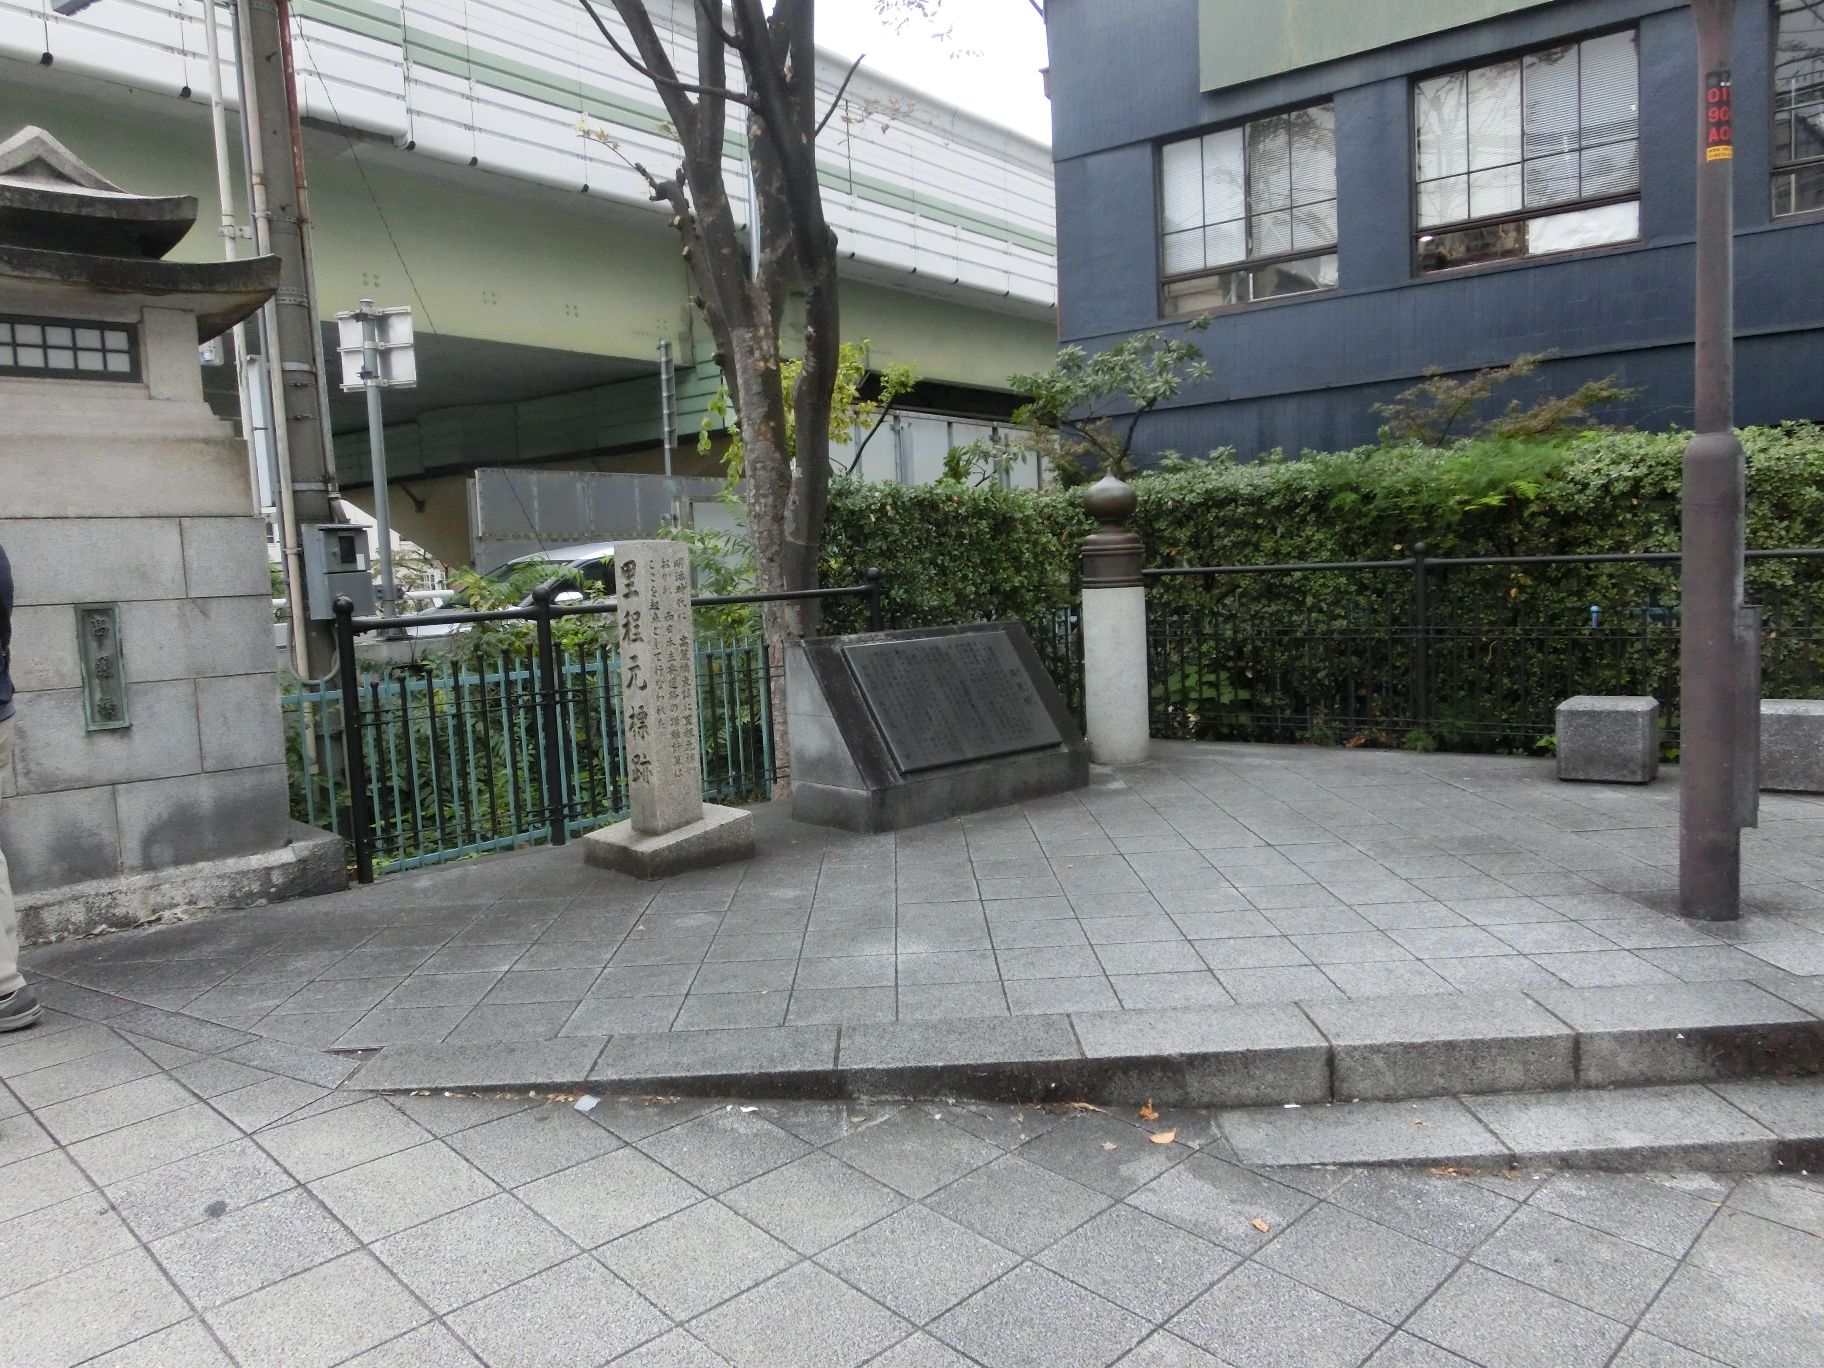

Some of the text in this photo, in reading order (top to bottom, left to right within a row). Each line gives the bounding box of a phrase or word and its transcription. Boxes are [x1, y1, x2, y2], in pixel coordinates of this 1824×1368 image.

[620, 559, 653, 785] 里程元標跡
